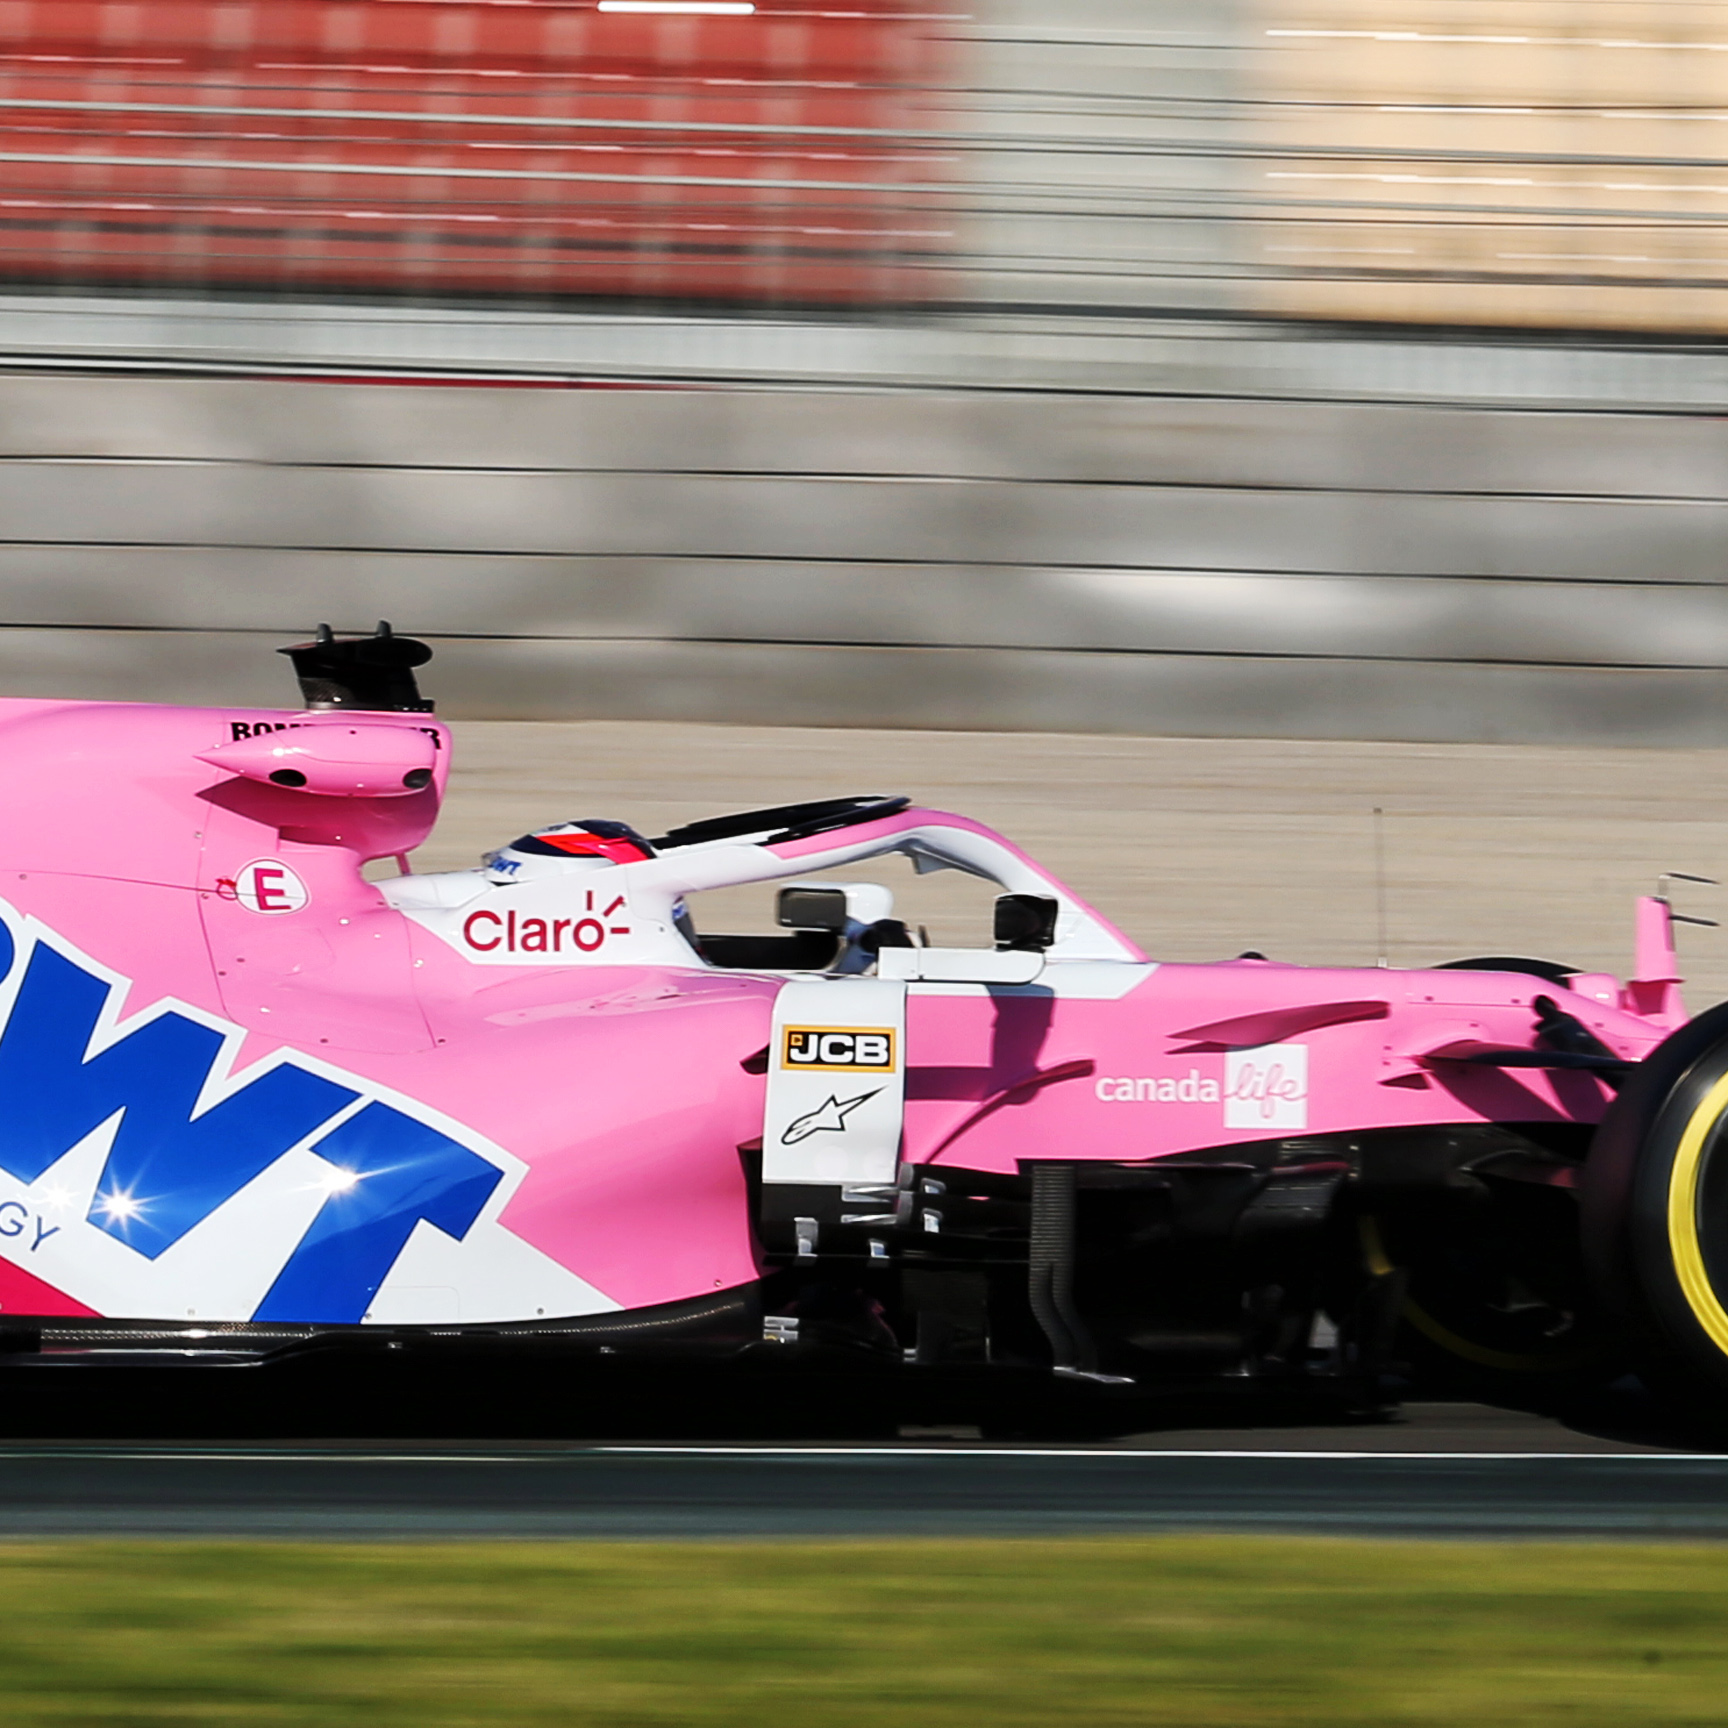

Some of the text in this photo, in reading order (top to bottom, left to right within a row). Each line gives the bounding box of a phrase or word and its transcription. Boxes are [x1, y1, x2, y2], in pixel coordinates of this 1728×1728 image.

[254, 867, 292, 911] E
[463, 909, 605, 953] Claro
[789, 1034, 889, 1064] JCB
[1094, 1062, 1308, 1119] canada life
